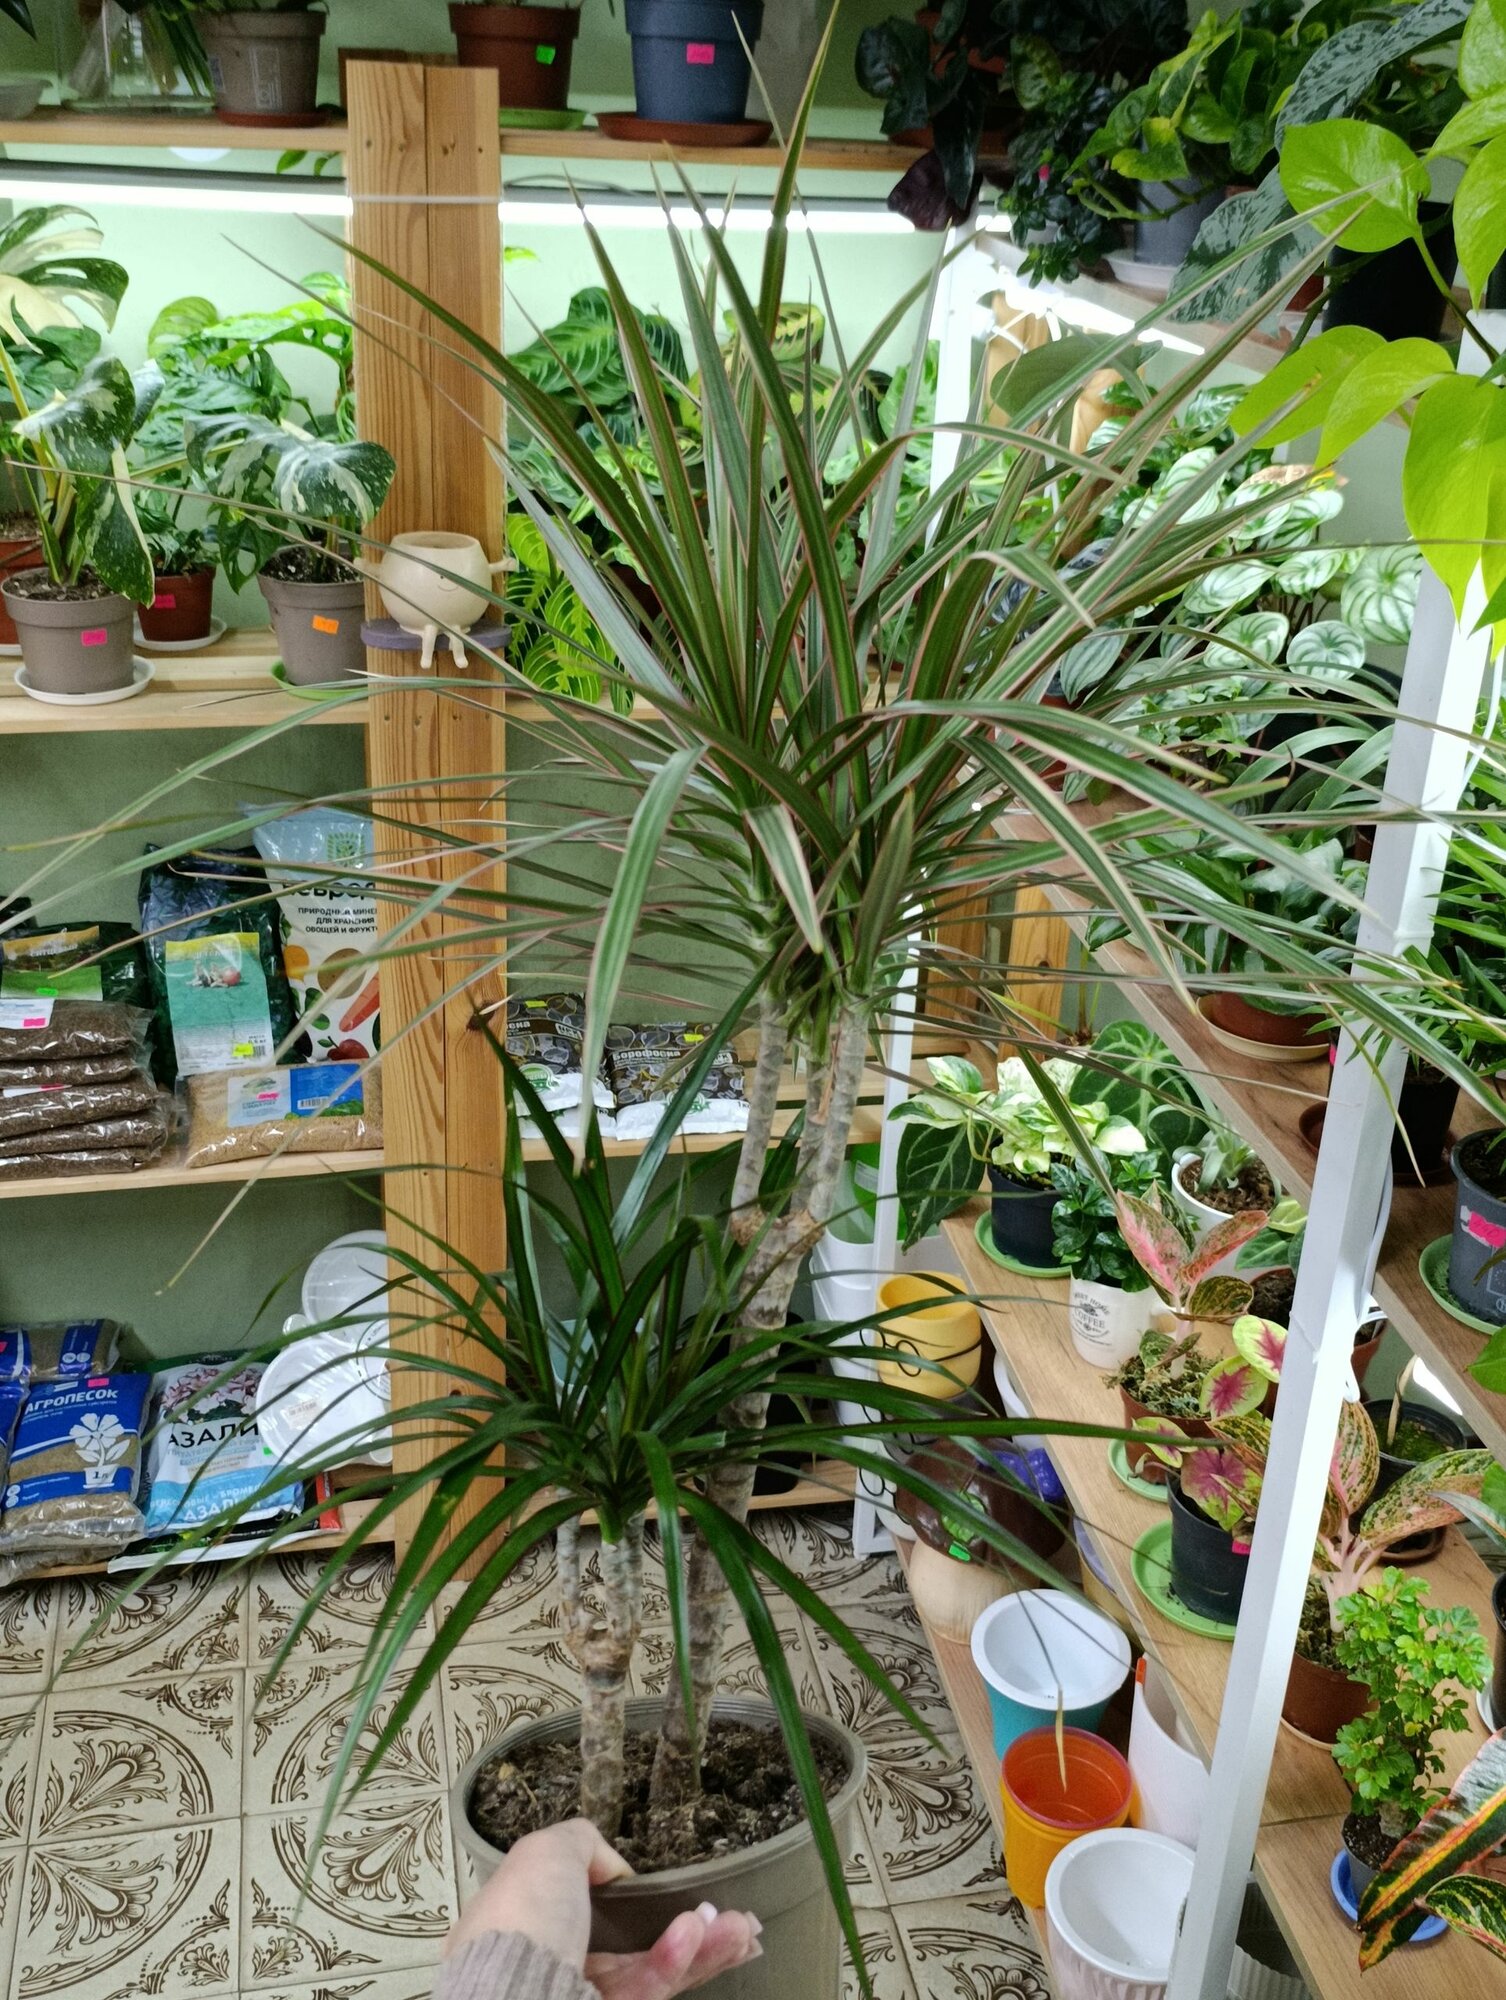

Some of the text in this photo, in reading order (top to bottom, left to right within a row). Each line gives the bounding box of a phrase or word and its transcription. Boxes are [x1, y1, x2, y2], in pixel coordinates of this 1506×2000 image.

[316, 917, 375, 925] ДЛЯ ХРАНЕНИЯ
[24, 1389, 119, 1415] АГРОПЕСОК
[169, 1423, 259, 1448] АЗАЛИ
